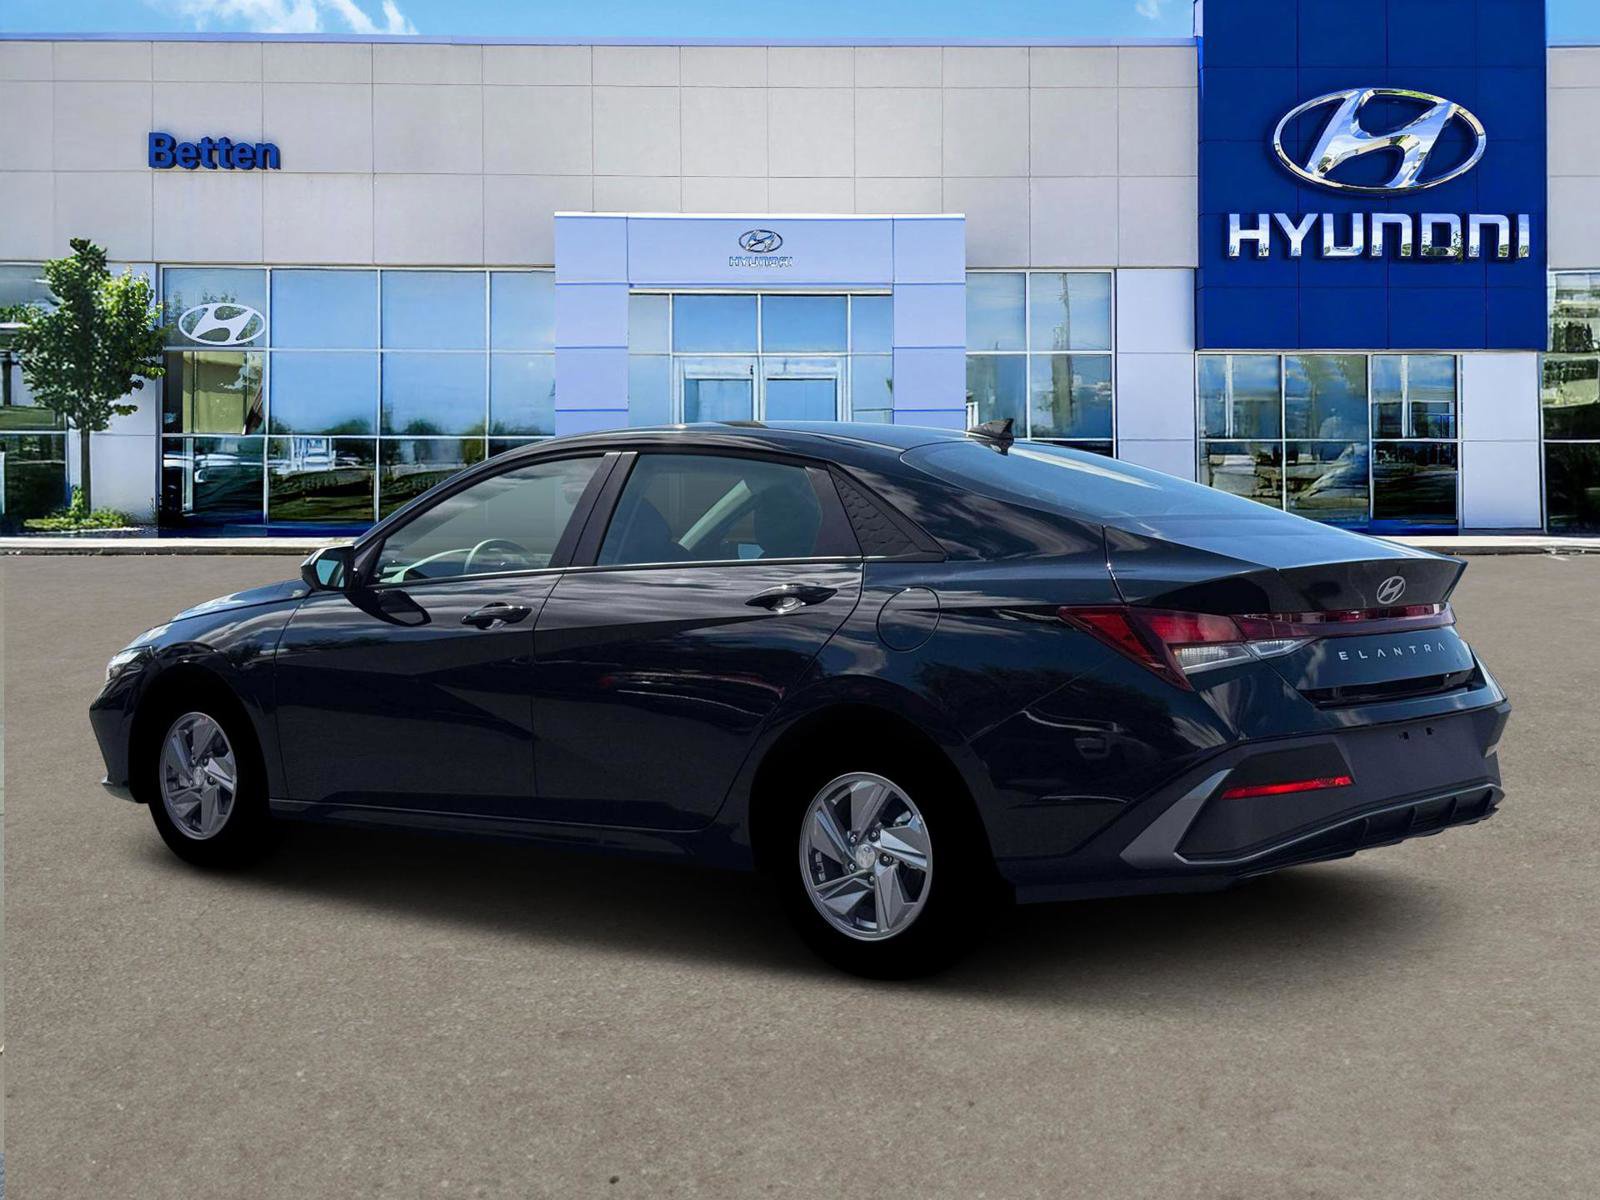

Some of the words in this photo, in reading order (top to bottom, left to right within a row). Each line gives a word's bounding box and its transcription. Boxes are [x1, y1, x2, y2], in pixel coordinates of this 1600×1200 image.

[148, 132, 281, 170] Betten
[1229, 213, 1530, 258] HYUNDAI
[728, 256, 793, 267] HYUNDAI
[1338, 642, 1446, 661] ELANTRA
